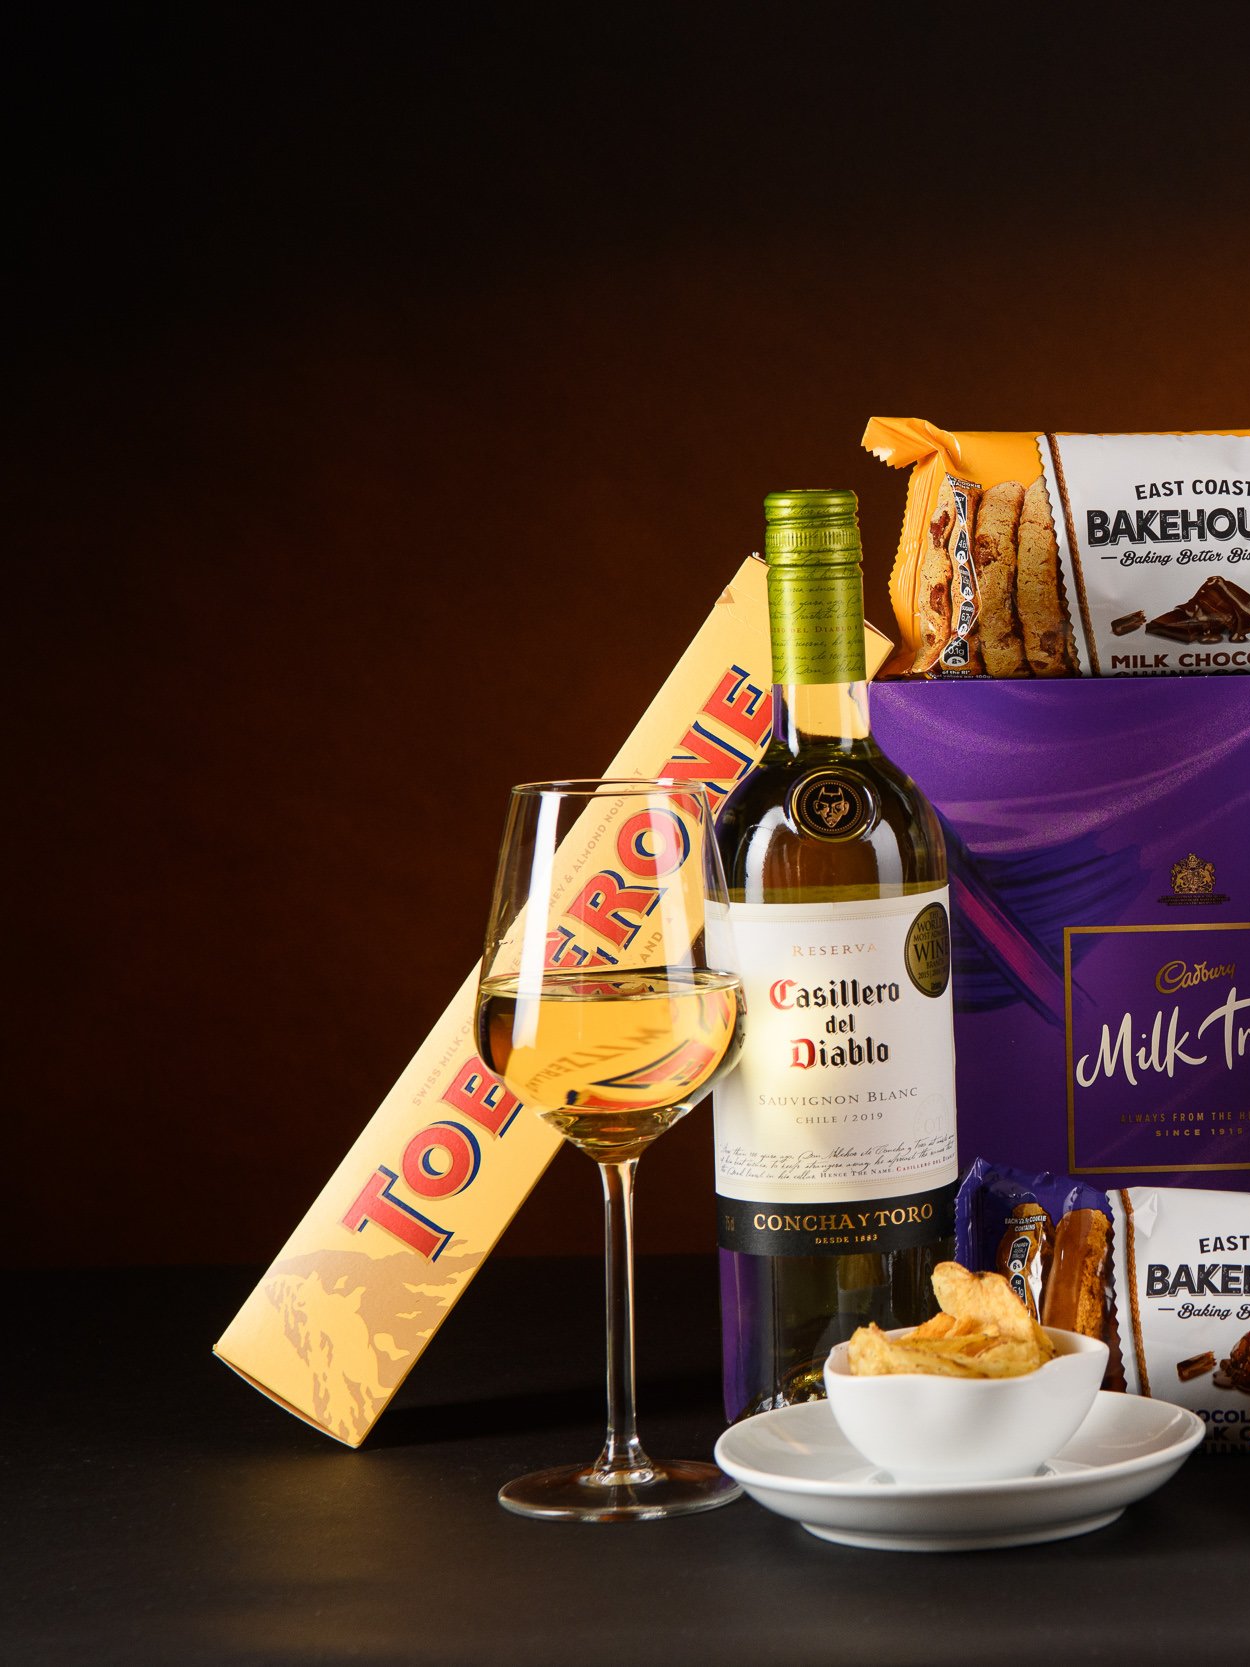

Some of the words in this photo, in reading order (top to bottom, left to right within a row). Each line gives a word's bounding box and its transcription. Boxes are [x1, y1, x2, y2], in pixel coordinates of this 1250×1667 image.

[1135, 480, 1184, 500] EAST
[1120, 550, 1173, 567] Baking
[1176, 548, 1223, 565] Better
[1111, 653, 1169, 669] MILK
[569, 823, 609, 873] ALMOND
[792, 943, 878, 957] RESERVA
[1155, 960, 1236, 995] Cadbury
[769, 979, 901, 1010] Casillero
[825, 1013, 856, 1035] del
[439, 1036, 463, 1067] MILK
[790, 1036, 891, 1070] Diablo
[1076, 1005, 1208, 1088] Milk
[759, 1094, 860, 1107] SAUVIGNON
[867, 1087, 918, 1102] BLANC
[796, 1115, 838, 1124] CHILE
[852, 1112, 883, 1123] 2019
[1120, 1112, 1166, 1123] ALWAYS
[1172, 1112, 1204, 1122] FROM
[1211, 1111, 1232, 1121] THE
[1155, 1129, 1201, 1137] SINCE
[753, 1213, 855, 1232] CONCHA
[873, 1203, 934, 1227] TORO
[815, 1235, 849, 1245] DESDE
[854, 1234, 878, 1243] 1883
[1199, 1235, 1250, 1254] EAST
[1177, 1302, 1232, 1320] Baking
